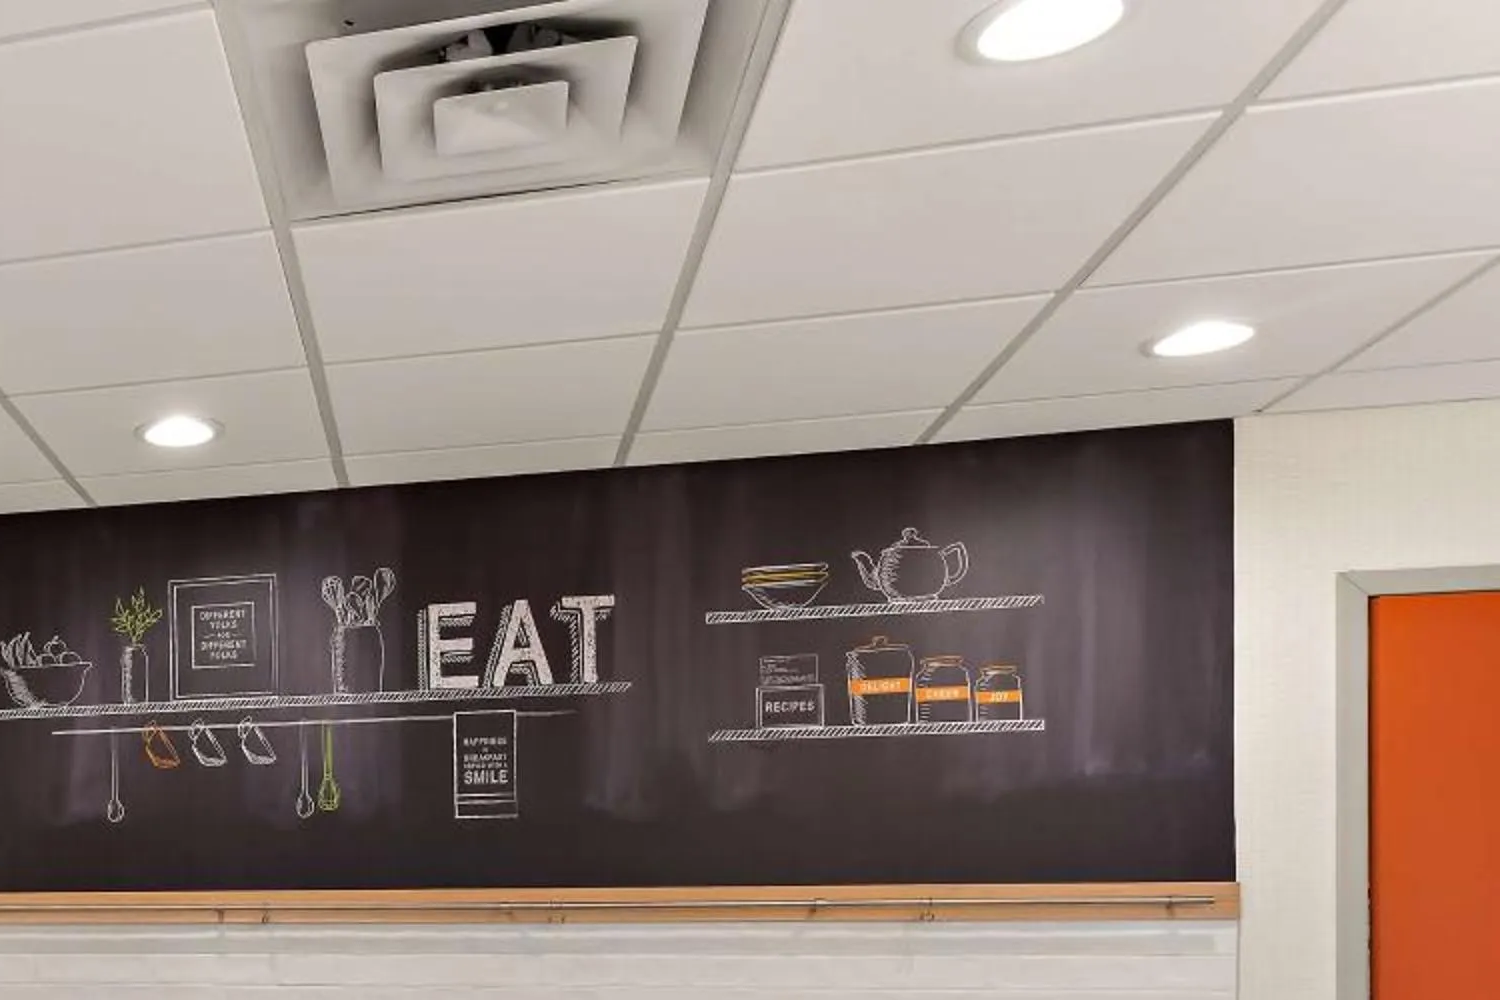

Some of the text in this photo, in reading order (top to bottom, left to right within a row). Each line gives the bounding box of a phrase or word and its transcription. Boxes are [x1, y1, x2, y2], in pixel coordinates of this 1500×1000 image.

[417, 594, 616, 692] EAT
[764, 700, 817, 713] RECIPES
[463, 769, 509, 785] SMILE
